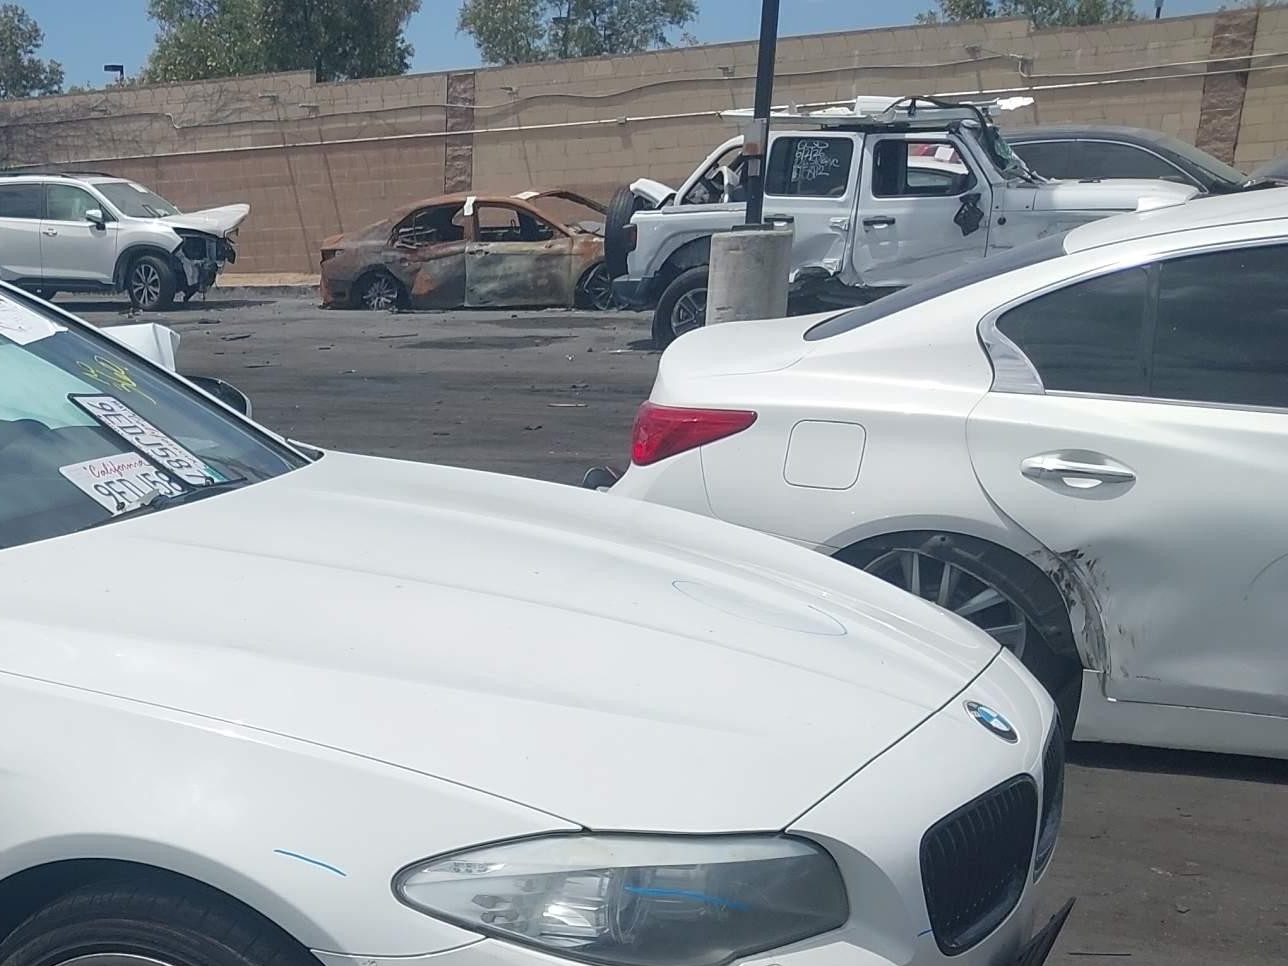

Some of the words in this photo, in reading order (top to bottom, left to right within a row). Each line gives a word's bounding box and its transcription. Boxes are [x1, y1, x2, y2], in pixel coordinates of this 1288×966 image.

[87, 402, 209, 479] 9EDJ587
[88, 459, 151, 478] California
[94, 470, 183, 504] 9EDJ58
